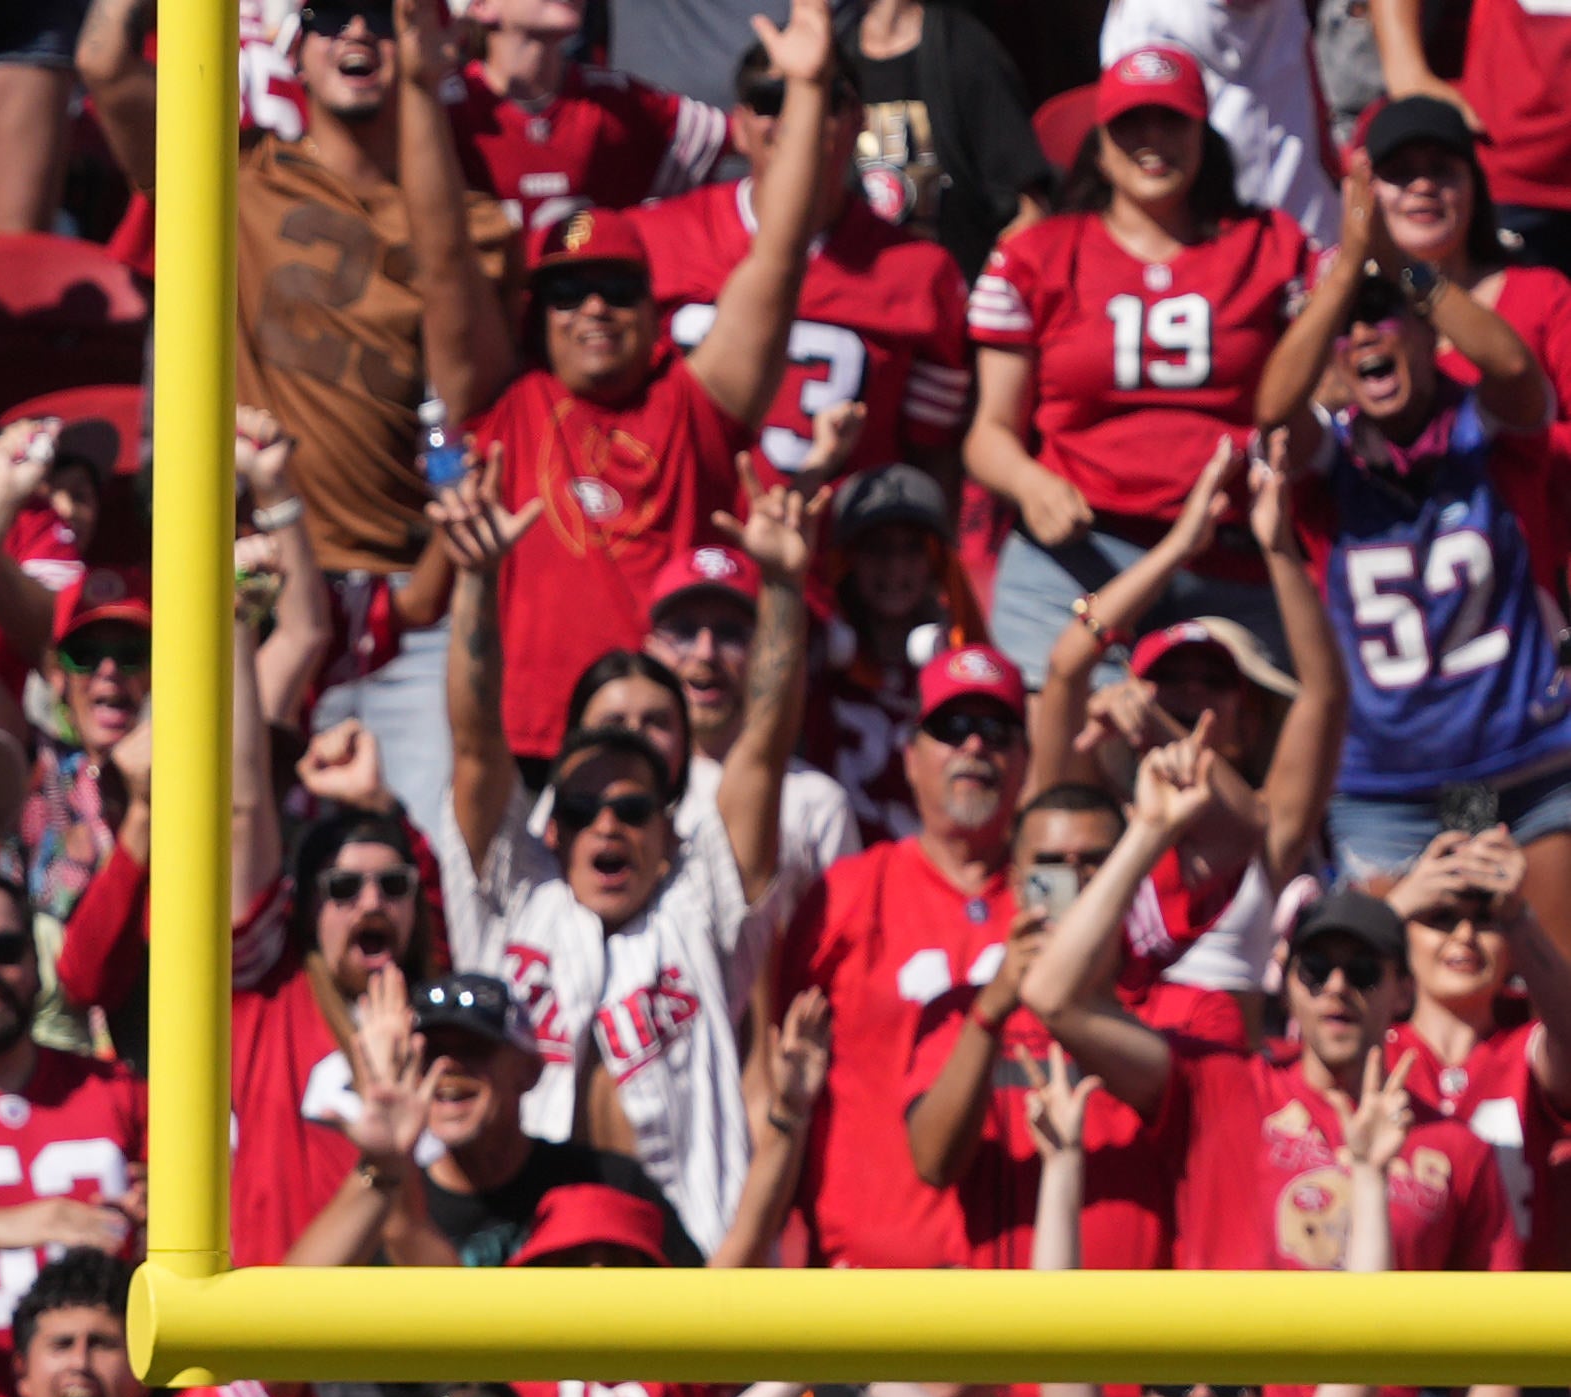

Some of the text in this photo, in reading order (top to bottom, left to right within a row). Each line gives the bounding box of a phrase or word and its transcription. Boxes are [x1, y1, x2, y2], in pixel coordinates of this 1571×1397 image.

[669, 300, 868, 470] 3
[1107, 293, 1213, 390] 19
[1344, 529, 1512, 690] 52
